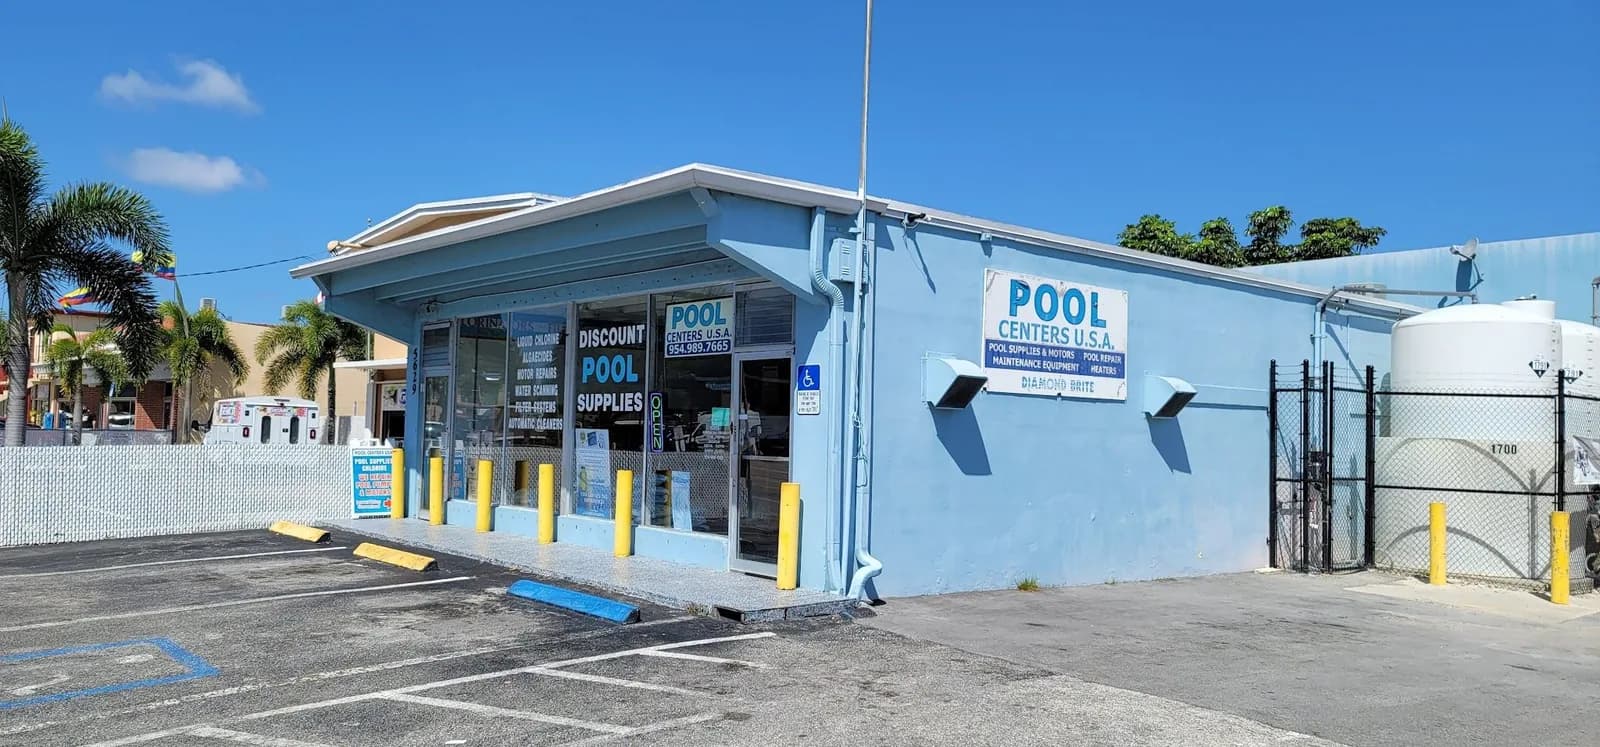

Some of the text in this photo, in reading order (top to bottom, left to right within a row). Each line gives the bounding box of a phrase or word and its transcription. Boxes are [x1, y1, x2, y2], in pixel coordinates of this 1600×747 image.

[1009, 279, 1107, 328] POOL
[672, 302, 726, 329] POOL
[517, 333, 560, 347] LIQUID CHLORINE
[579, 324, 645, 348] DISCOUNT
[666, 328, 732, 343] CENTERS U.S.A.
[999, 320, 1114, 350] CENTERS U.S.A.
[668, 340, 728, 354] 954.989.7665
[989, 343, 1074, 359] POOL SUPPLIES & MOTORS
[522, 350, 552, 364] ALGAECIDES
[992, 356, 1079, 372] MAINTENANCE EQUIPMENT
[1084, 352, 1122, 364] POOL REPAIR
[517, 367, 556, 380] MOTOR REPAIRS
[582, 354, 638, 384] POOL
[1090, 364, 1116, 375] HEATERS
[514, 384, 558, 396] WATER SCANNING
[1022, 376, 1094, 392] DIAMOND BRITE
[515, 401, 556, 413] FILTER SYSTEMS
[577, 392, 642, 412] SUPPLIES
[508, 418, 562, 430] AUTOMATIC CLEANERS
[652, 395, 661, 449] OPEN
[1491, 444, 1517, 454] 1700
